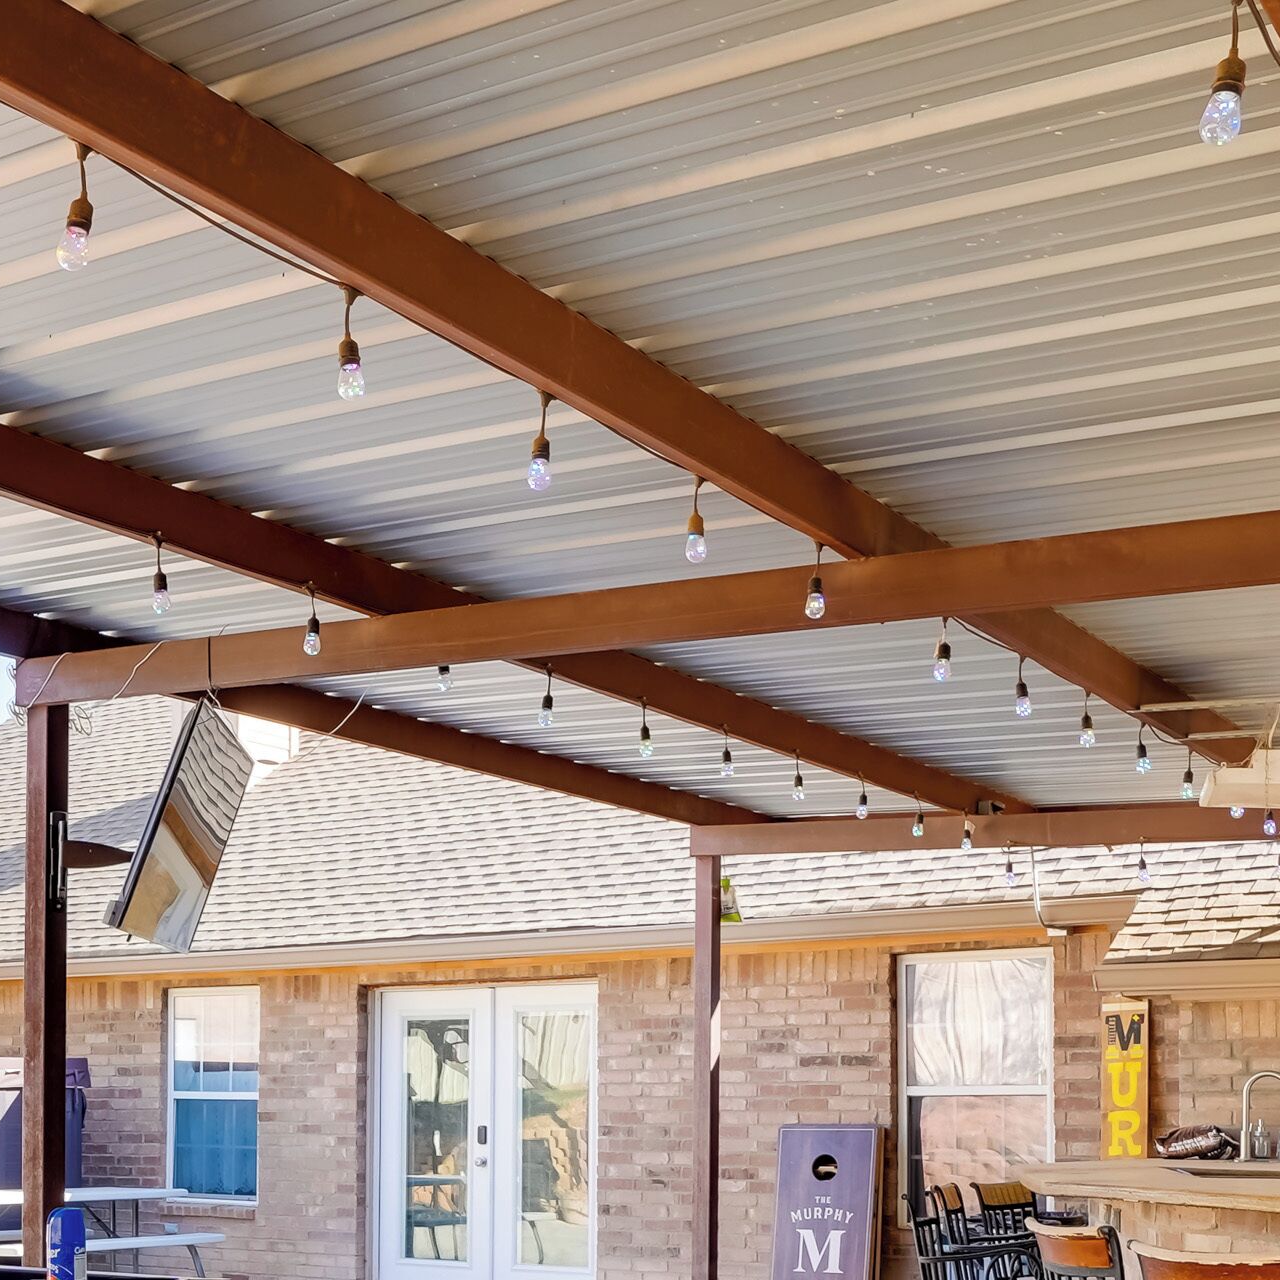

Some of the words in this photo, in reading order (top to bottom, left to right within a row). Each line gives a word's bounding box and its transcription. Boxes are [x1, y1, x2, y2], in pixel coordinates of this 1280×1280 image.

[814, 1196, 832, 1204] THE
[790, 1207, 854, 1224] MURPHY
[792, 1228, 847, 1274] M
